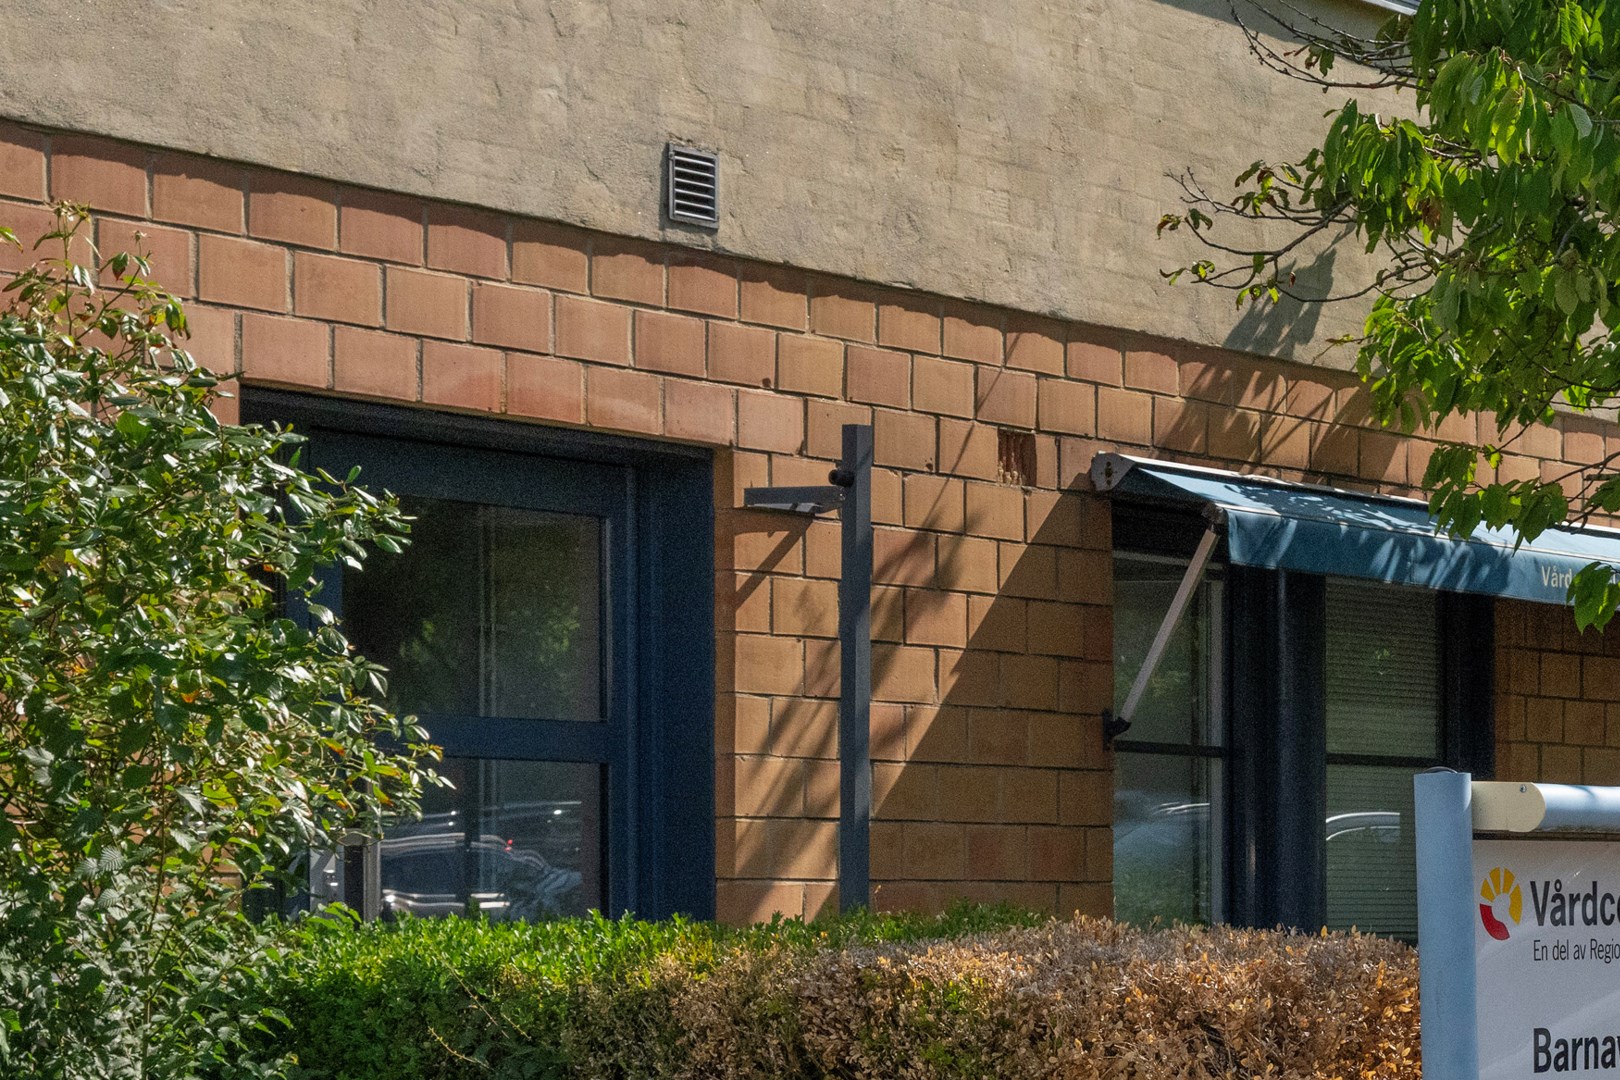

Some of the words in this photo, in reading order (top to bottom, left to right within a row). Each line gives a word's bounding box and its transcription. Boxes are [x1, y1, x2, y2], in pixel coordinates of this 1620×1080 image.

[1533, 939, 1549, 961] En
[1552, 939, 1570, 961] del
[1573, 943, 1587, 961] av
